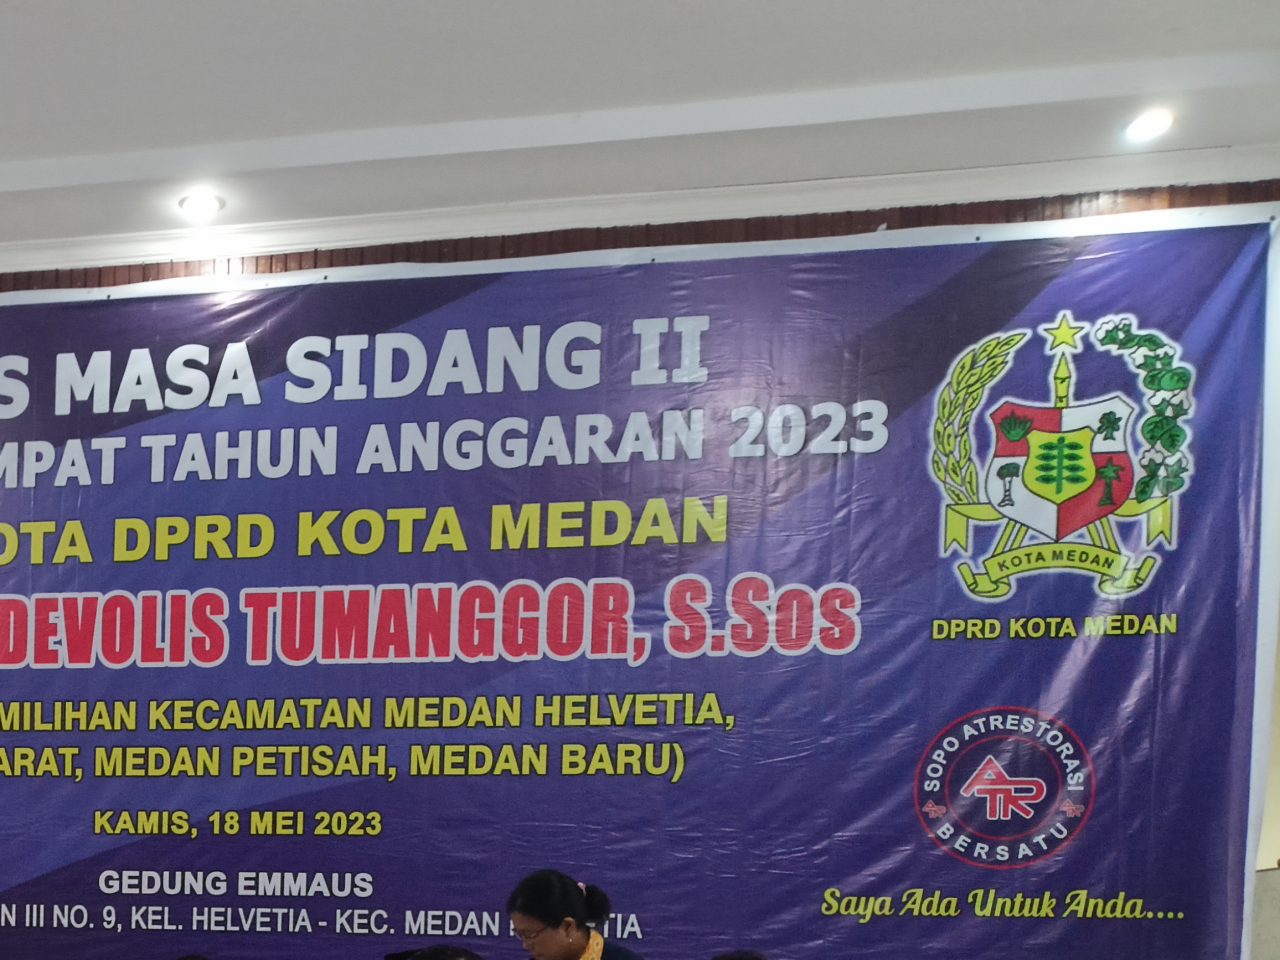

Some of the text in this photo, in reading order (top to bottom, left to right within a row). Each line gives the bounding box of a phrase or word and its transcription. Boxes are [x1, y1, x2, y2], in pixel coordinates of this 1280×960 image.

[54, 341, 261, 416] MASA
[284, 320, 602, 403] SIDANG
[631, 315, 710, 385] II
[140, 426, 338, 483] TAHUN
[356, 408, 704, 474] ANGGARAN
[728, 399, 889, 458] 2023
[113, 514, 275, 563] DPRD
[297, 507, 468, 556] KOTA
[490, 495, 728, 550] MEDAN
[997, 550, 1115, 573] KOTA MEDAN
[240, 577, 652, 667] TUMANGGOR,
[931, 613, 1177, 640] DPRD KOTA MEDAN
[148, 698, 372, 730] KECAMATAN
[384, 696, 520, 728] MEDAN
[534, 692, 736, 731] HELVETIA,
[94, 746, 220, 776] MEDAN
[231, 745, 397, 782] PETISAH,
[409, 744, 548, 776] MEDAN
[561, 743, 686, 782] BARU)
[924, 714, 1084, 792] SOPO ATRESTORASI
[93, 810, 383, 840] KAMIS, 18 MEI 2023
[936, 822, 1068, 861] BERSATU
[98, 870, 374, 898] GEDUNG EMMAUS
[25, 904, 45, 928] III
[52, 905, 95, 930] NO.
[102, 905, 123, 932] 9,
[131, 907, 184, 932] KEL.
[192, 907, 313, 933] HELVETIA
[335, 909, 395, 935] KEC.
[405, 910, 500, 937] MEDAN
[821, 888, 894, 923] Saya
[899, 887, 962, 919] Ada
[967, 888, 1057, 919] Untuk
